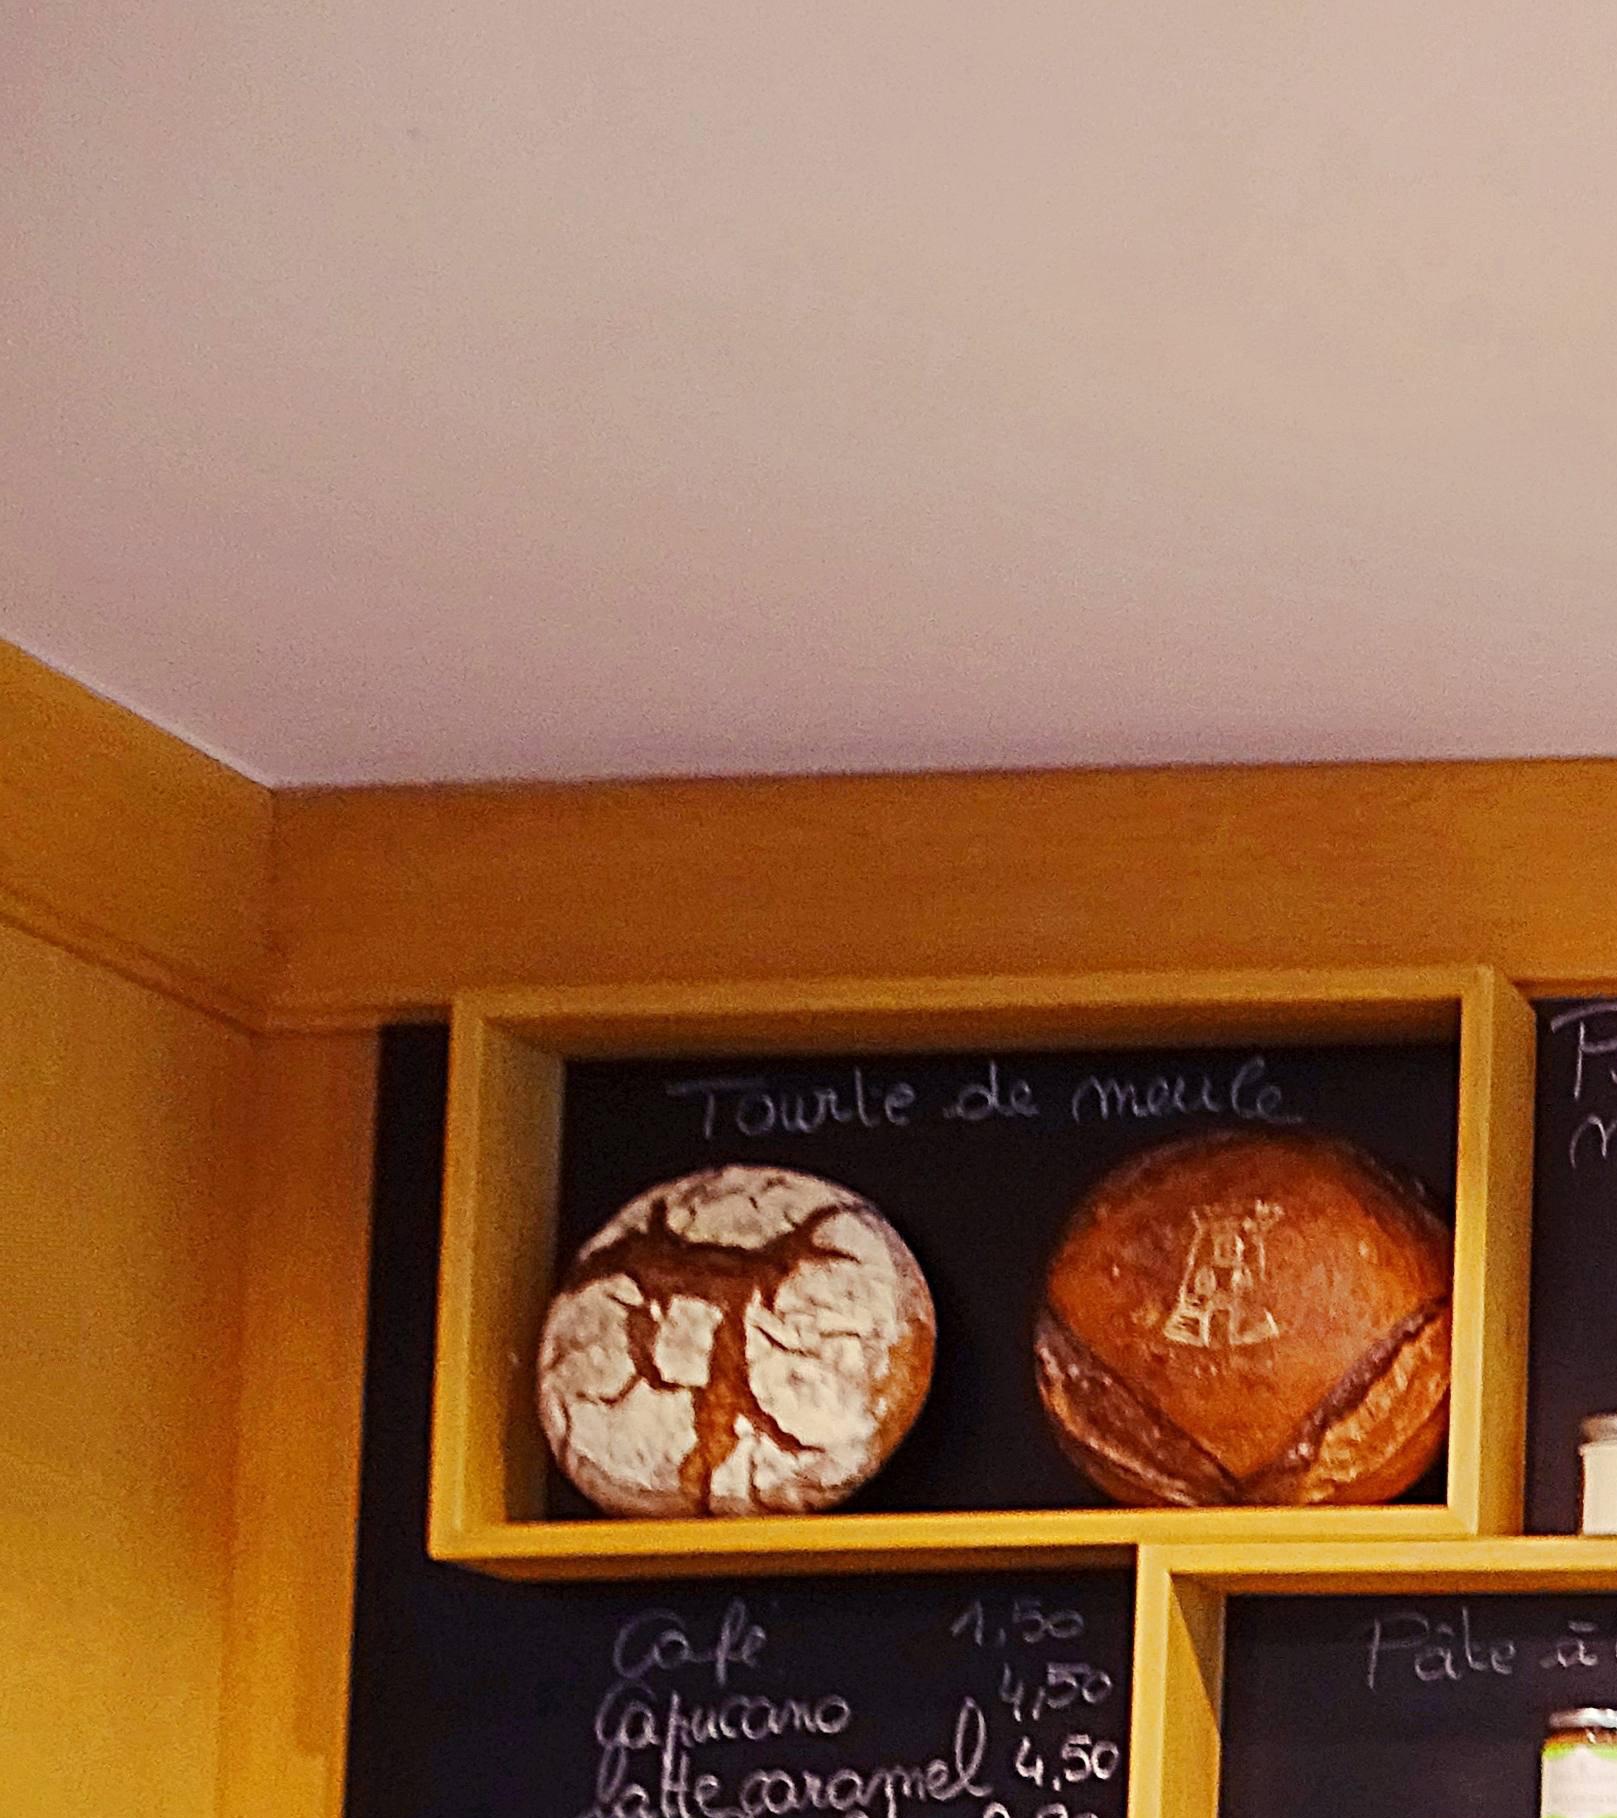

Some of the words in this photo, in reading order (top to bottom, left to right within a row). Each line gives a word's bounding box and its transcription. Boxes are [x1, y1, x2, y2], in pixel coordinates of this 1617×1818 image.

[943, 1059, 1040, 1121] de
[1367, 1605, 1516, 1690] Pâte
[1016, 1734, 1120, 1791] 4,50
